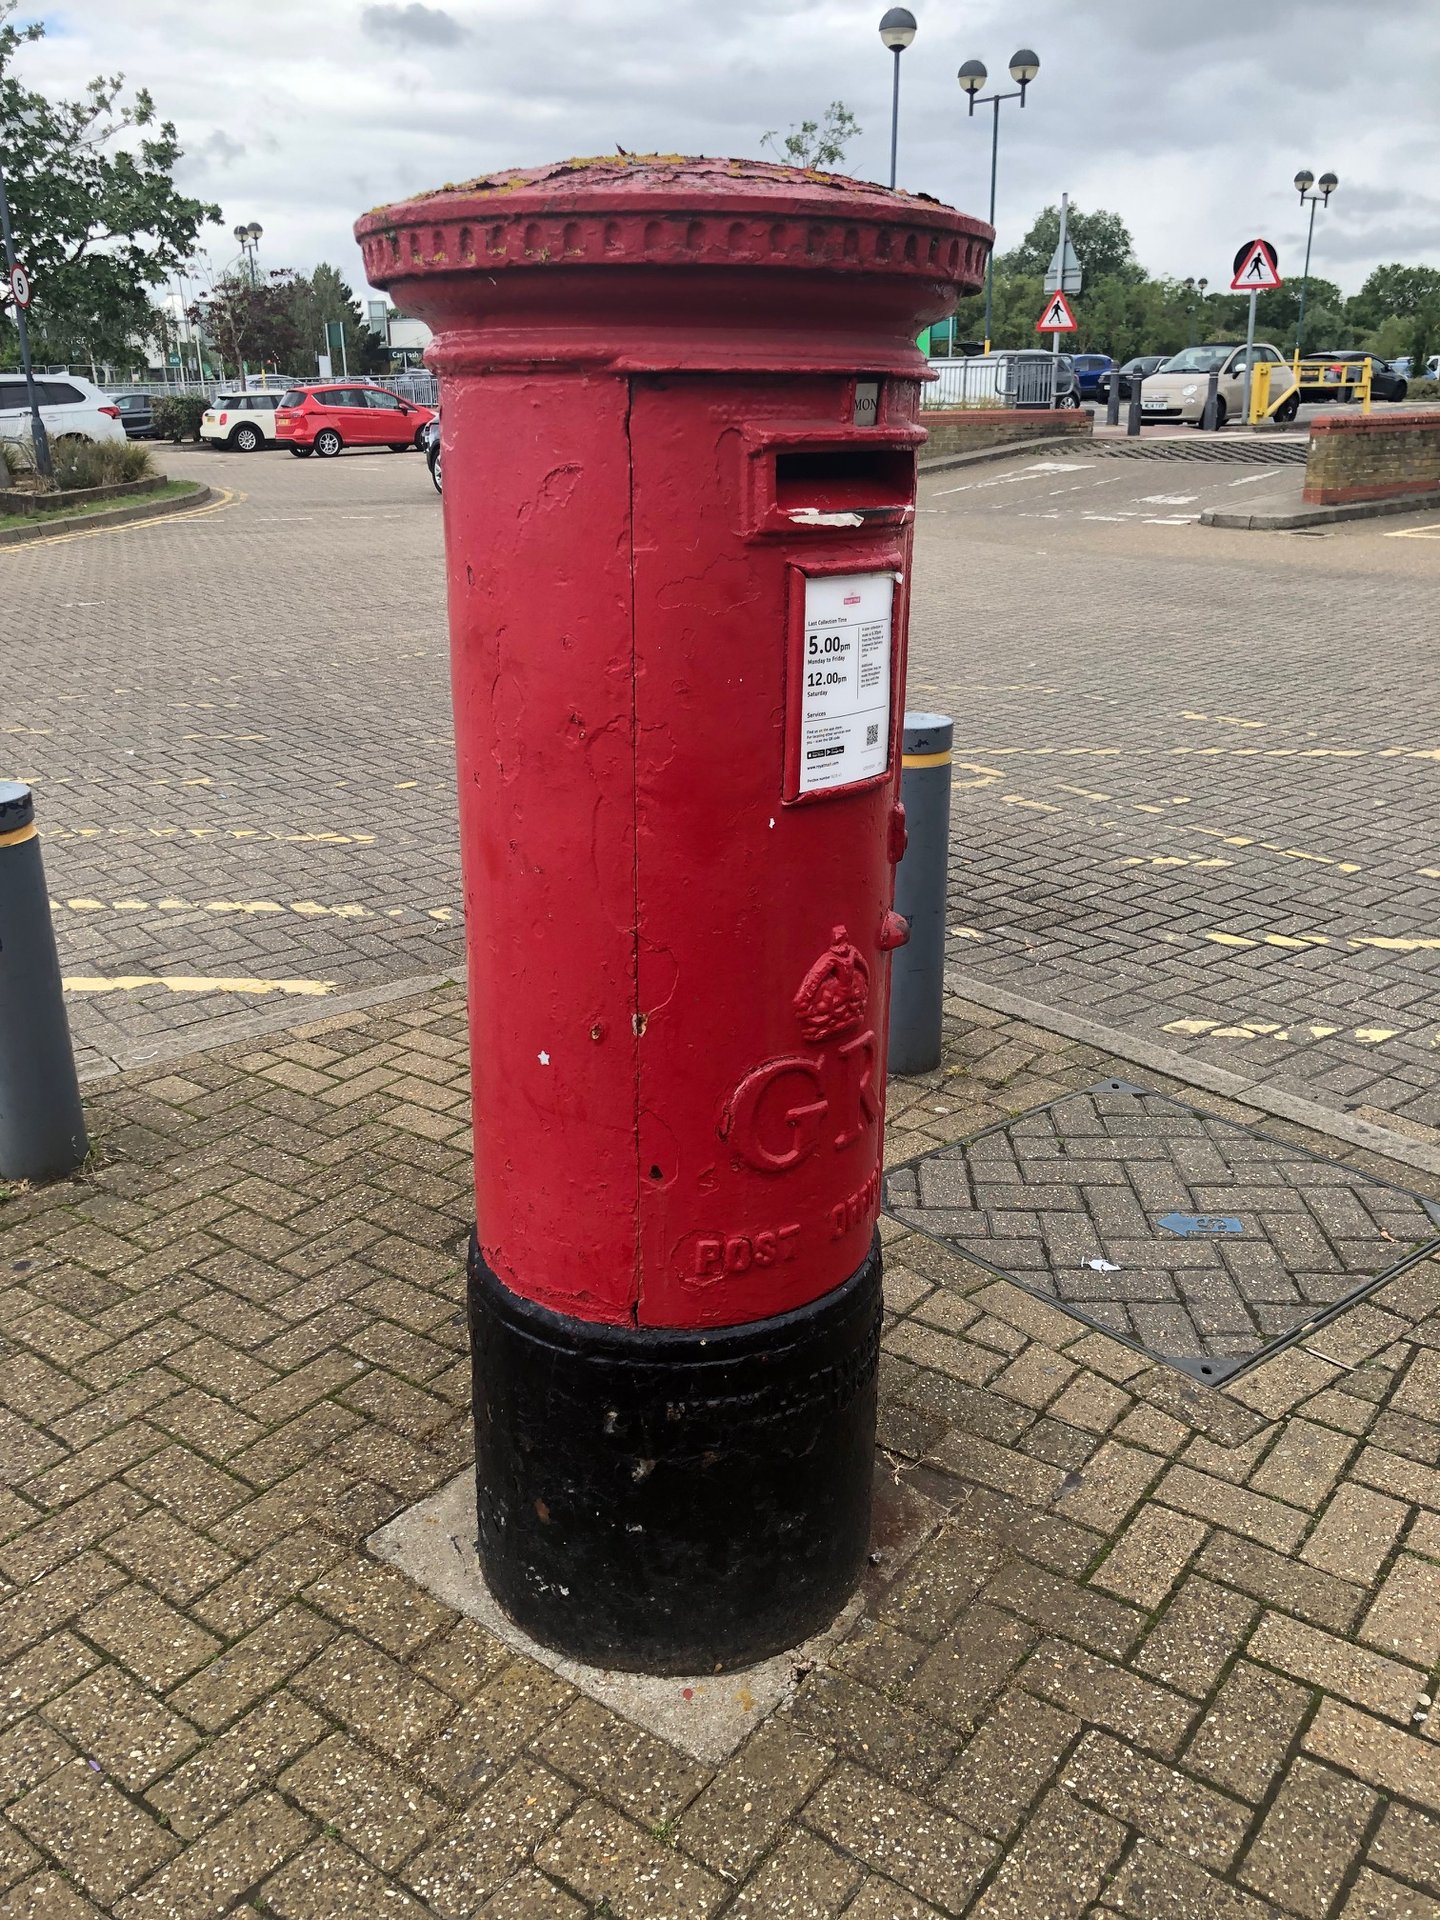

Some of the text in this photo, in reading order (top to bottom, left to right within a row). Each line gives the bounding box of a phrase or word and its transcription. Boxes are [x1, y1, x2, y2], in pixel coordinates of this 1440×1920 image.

[17, 278, 24, 294] 5
[809, 635, 850, 654] 5.00pm
[808, 672, 847, 687] 12.00pm
[695, 1223, 801, 1276] POST
